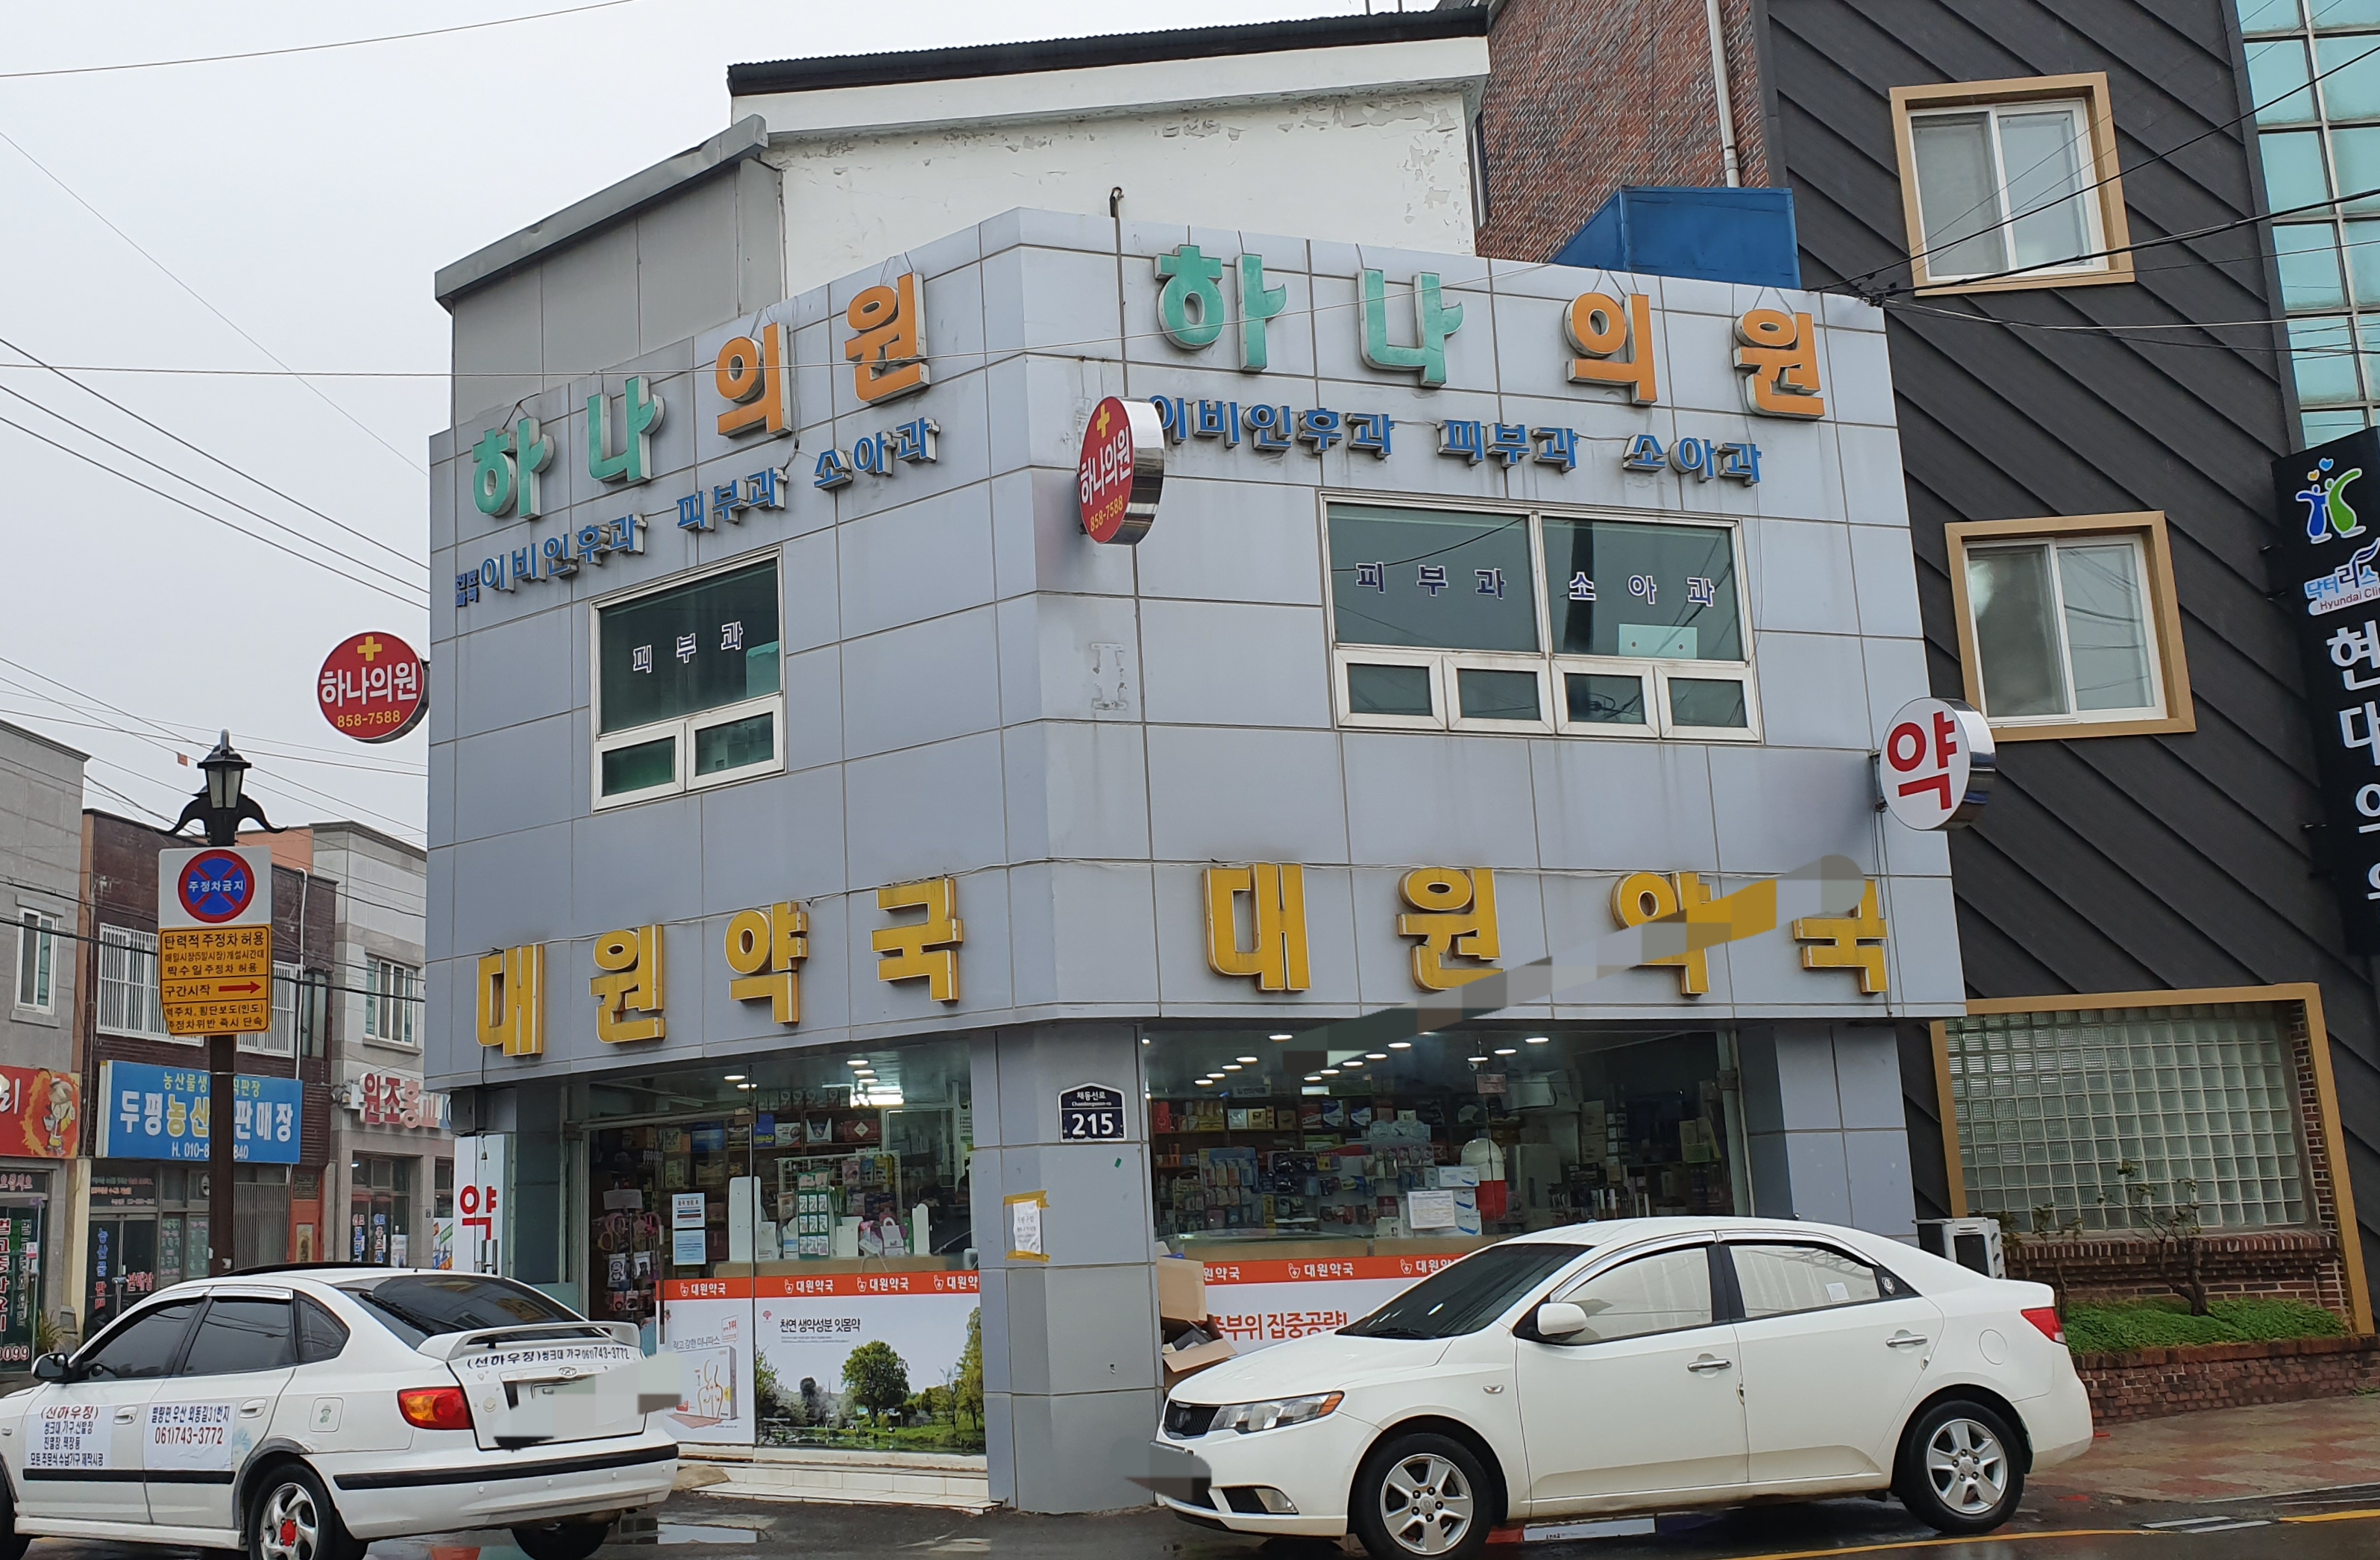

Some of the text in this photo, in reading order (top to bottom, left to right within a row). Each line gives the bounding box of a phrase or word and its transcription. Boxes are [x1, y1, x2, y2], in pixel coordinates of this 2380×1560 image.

[1149, 395, 1762, 486] 이비인후과 피부과 소아과
[1081, 426, 1131, 506] 하나의원
[480, 416, 940, 593] 이비인후과 피부과 소아과
[1090, 495, 1123, 532] 858-7588
[1356, 562, 1715, 607] 피부과 소아과
[2307, 551, 2379, 598] 닥터리스
[2320, 586, 2380, 610] Hyundai Cli
[633, 621, 743, 674] 피부과
[321, 662, 417, 707] 하나의원
[338, 709, 401, 727] 858-7588
[1887, 711, 1957, 810] 약
[2326, 619, 2380, 900] 현대
[189, 880, 244, 892] 주정차금지
[165, 931, 264, 950] 탄력적 주정차 허용
[167, 962, 257, 976] 짝수일 주정차 허용
[476, 877, 963, 1056] 대원약국
[165, 984, 210, 997] 구간시작
[220, 1018, 239, 1027] 즉시
[243, 1017, 263, 1027] 단속
[1072, 1113, 1114, 1135] 215
[459, 1185, 497, 1241] 약
[1304, 1262, 1354, 1277] 대원약국
[691, 1282, 726, 1297] 대원약국
[796, 1279, 834, 1293] 대원약국
[870, 1276, 910, 1291] 대원약국
[780, 1318, 861, 1333] 천연 생약성분 잇몸약
[566, 1349, 581, 1359] 가구
[173, 1406, 186, 1423] 우산
[154, 1426, 223, 1444] 061)743-3772
